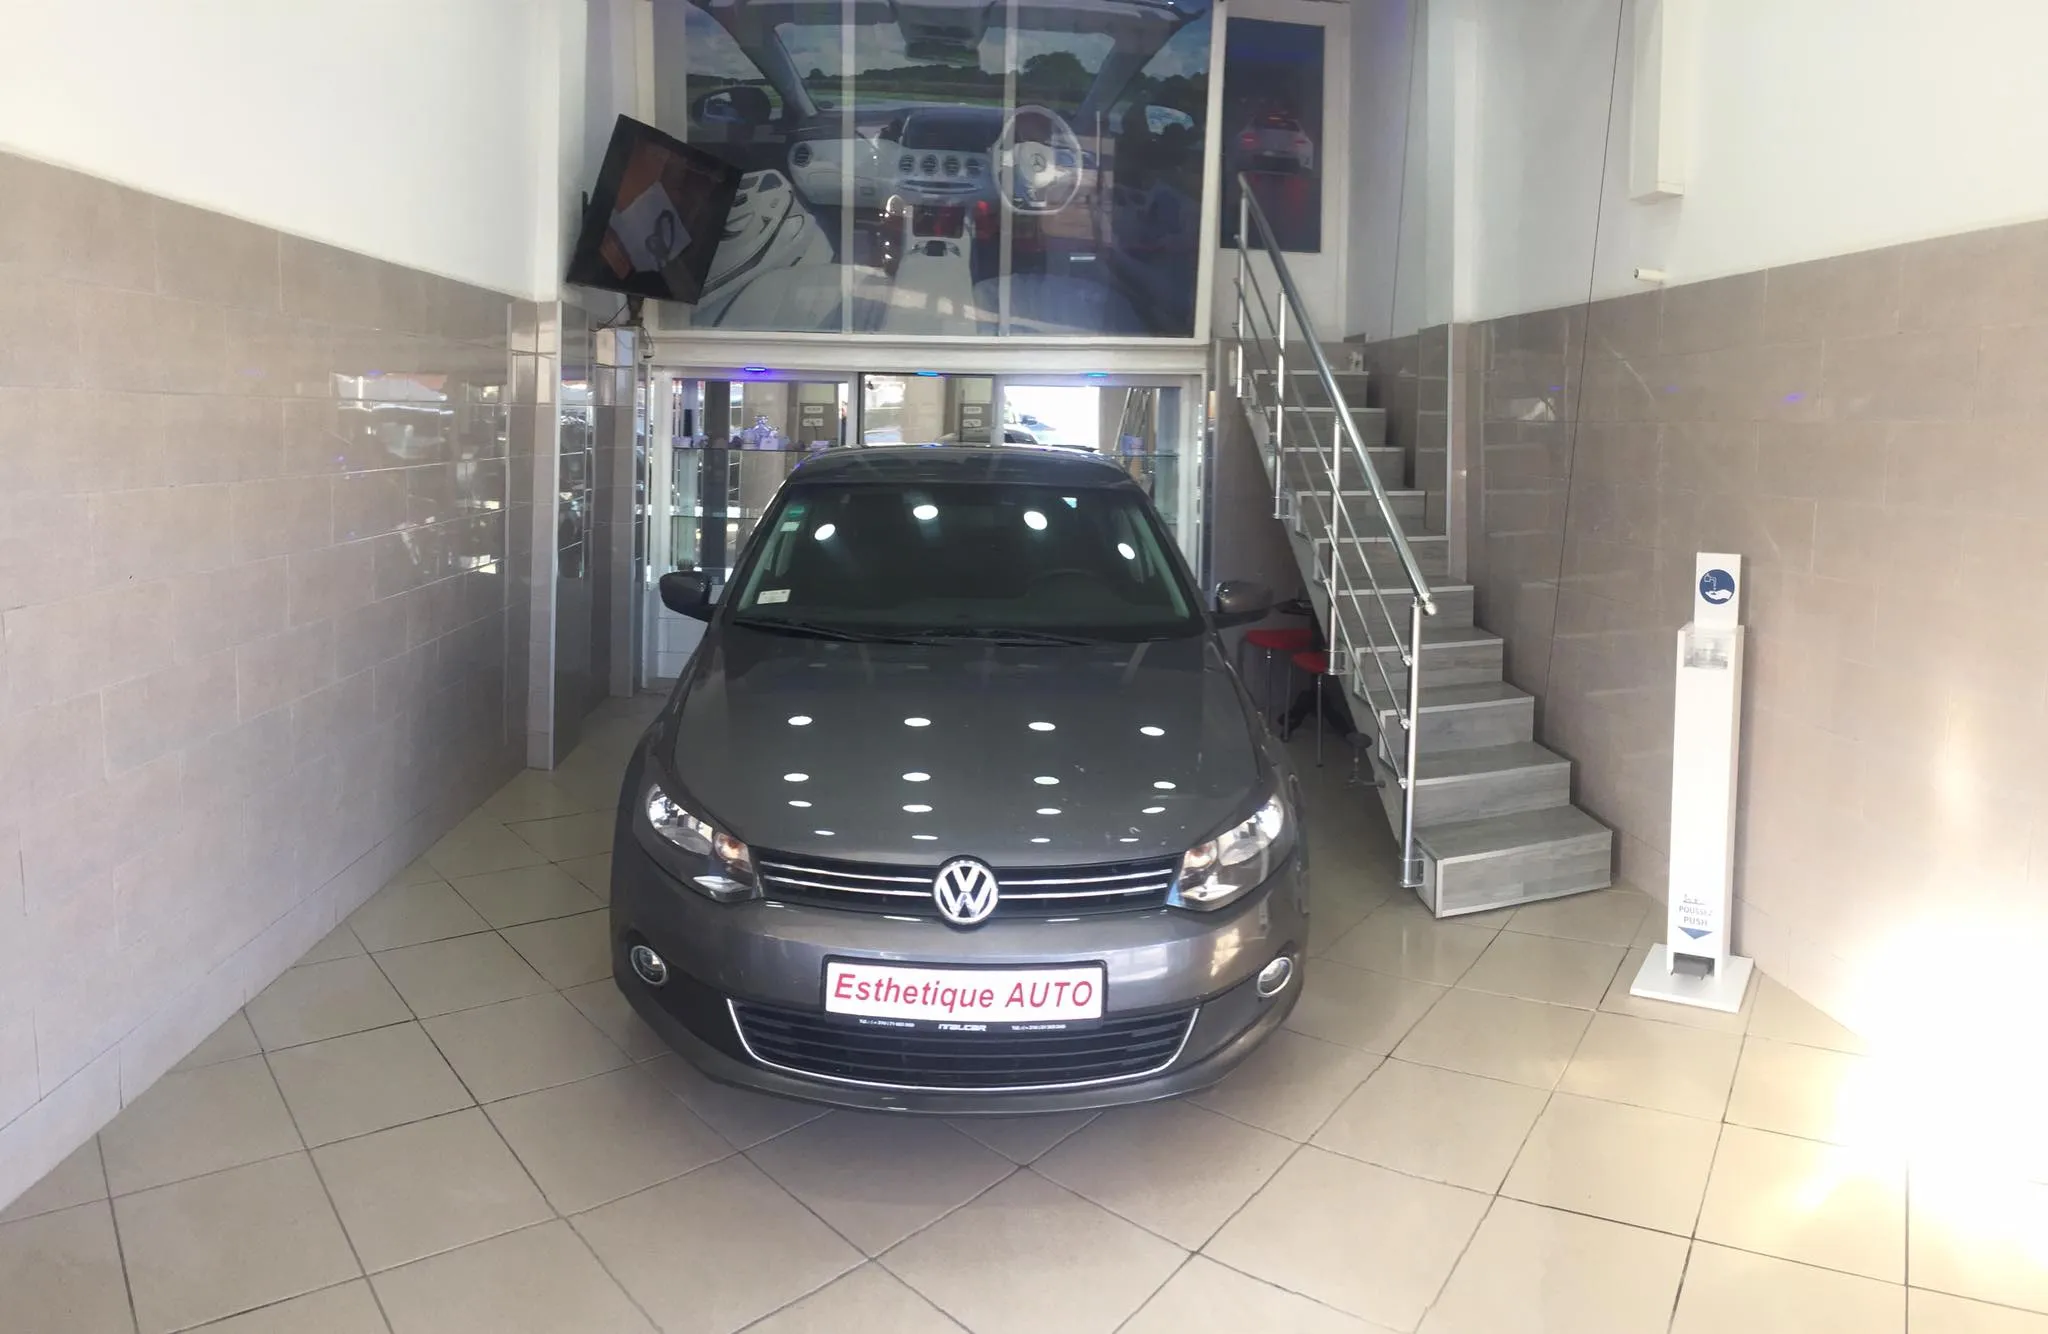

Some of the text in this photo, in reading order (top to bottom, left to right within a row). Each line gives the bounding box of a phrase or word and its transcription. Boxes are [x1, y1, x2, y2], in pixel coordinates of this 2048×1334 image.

[1683, 916, 1708, 927] PUSH
[834, 973, 1093, 1013] Esthetique AUTO
